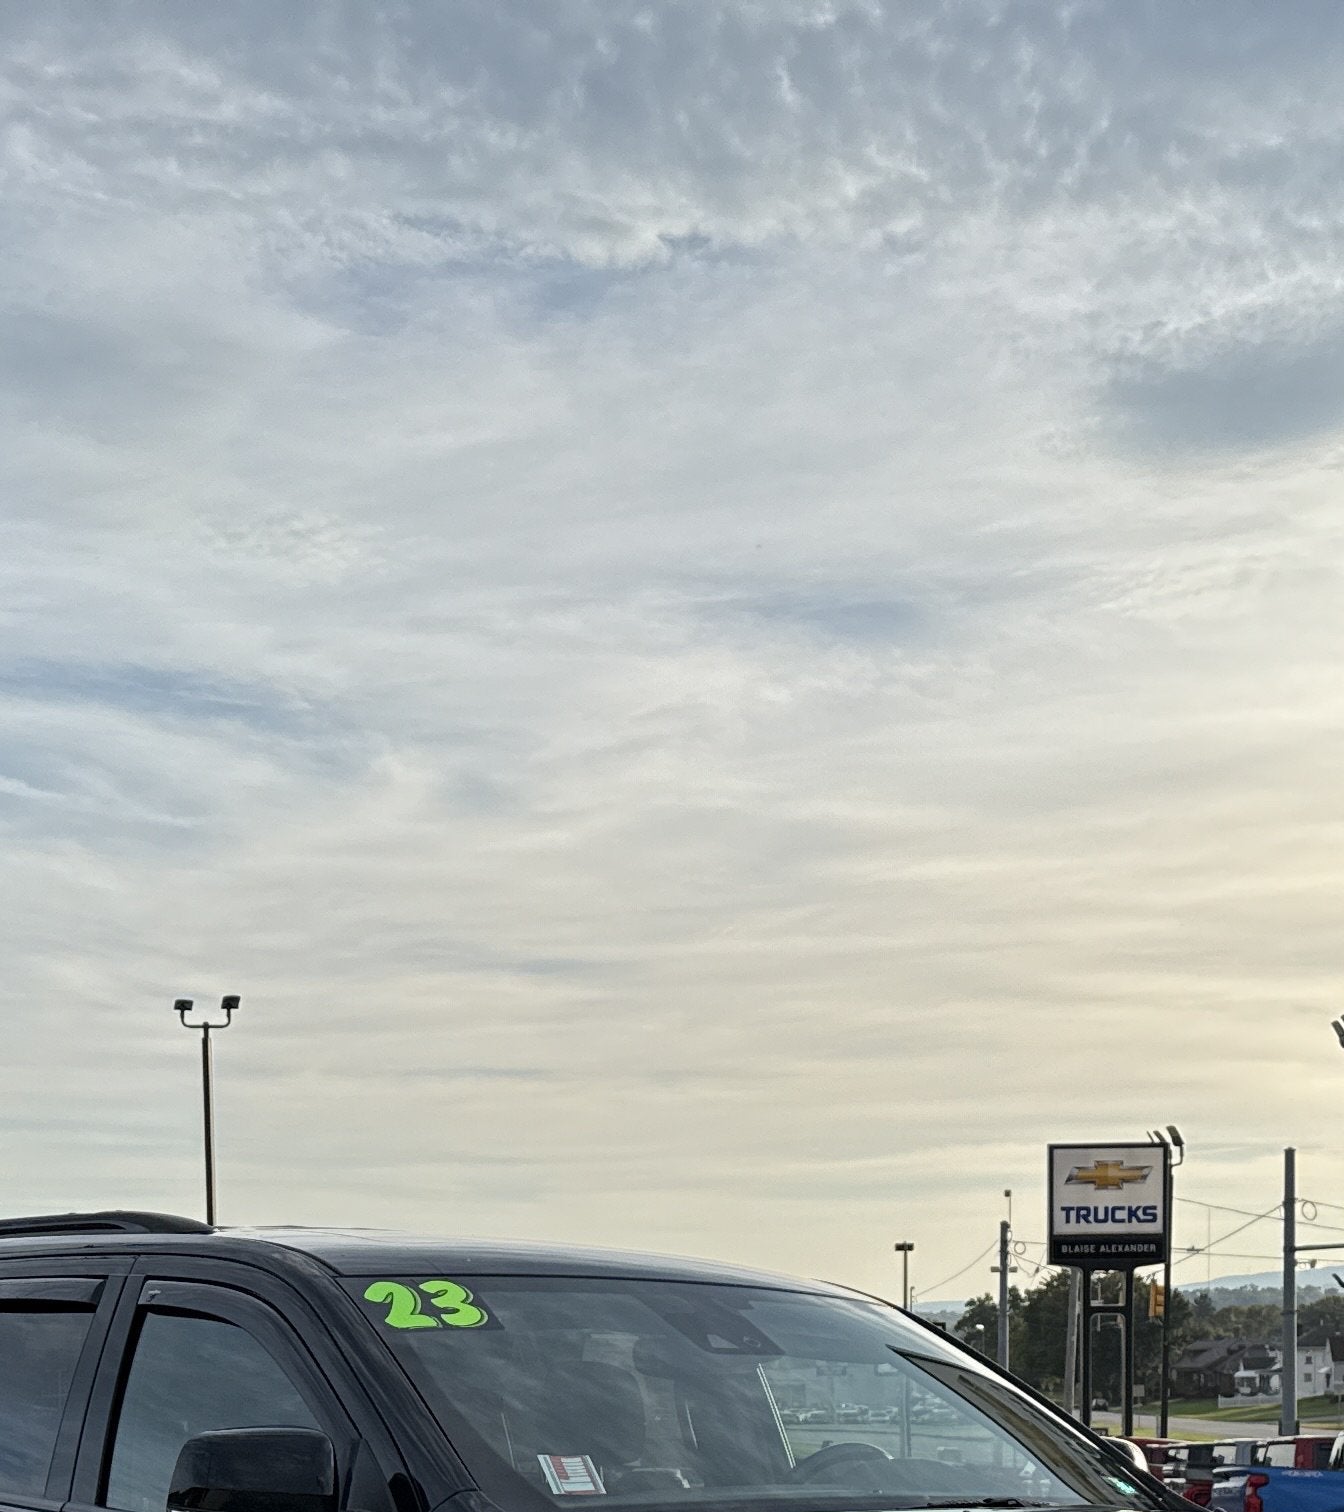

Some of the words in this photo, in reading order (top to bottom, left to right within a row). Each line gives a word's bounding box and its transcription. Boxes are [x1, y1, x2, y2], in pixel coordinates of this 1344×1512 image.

[1060, 1205, 1158, 1224] TRUCKS
[1061, 1243, 1097, 1254] BLAISE
[1099, 1243, 1157, 1254] ALEXANDER
[363, 1280, 489, 1329] 23
